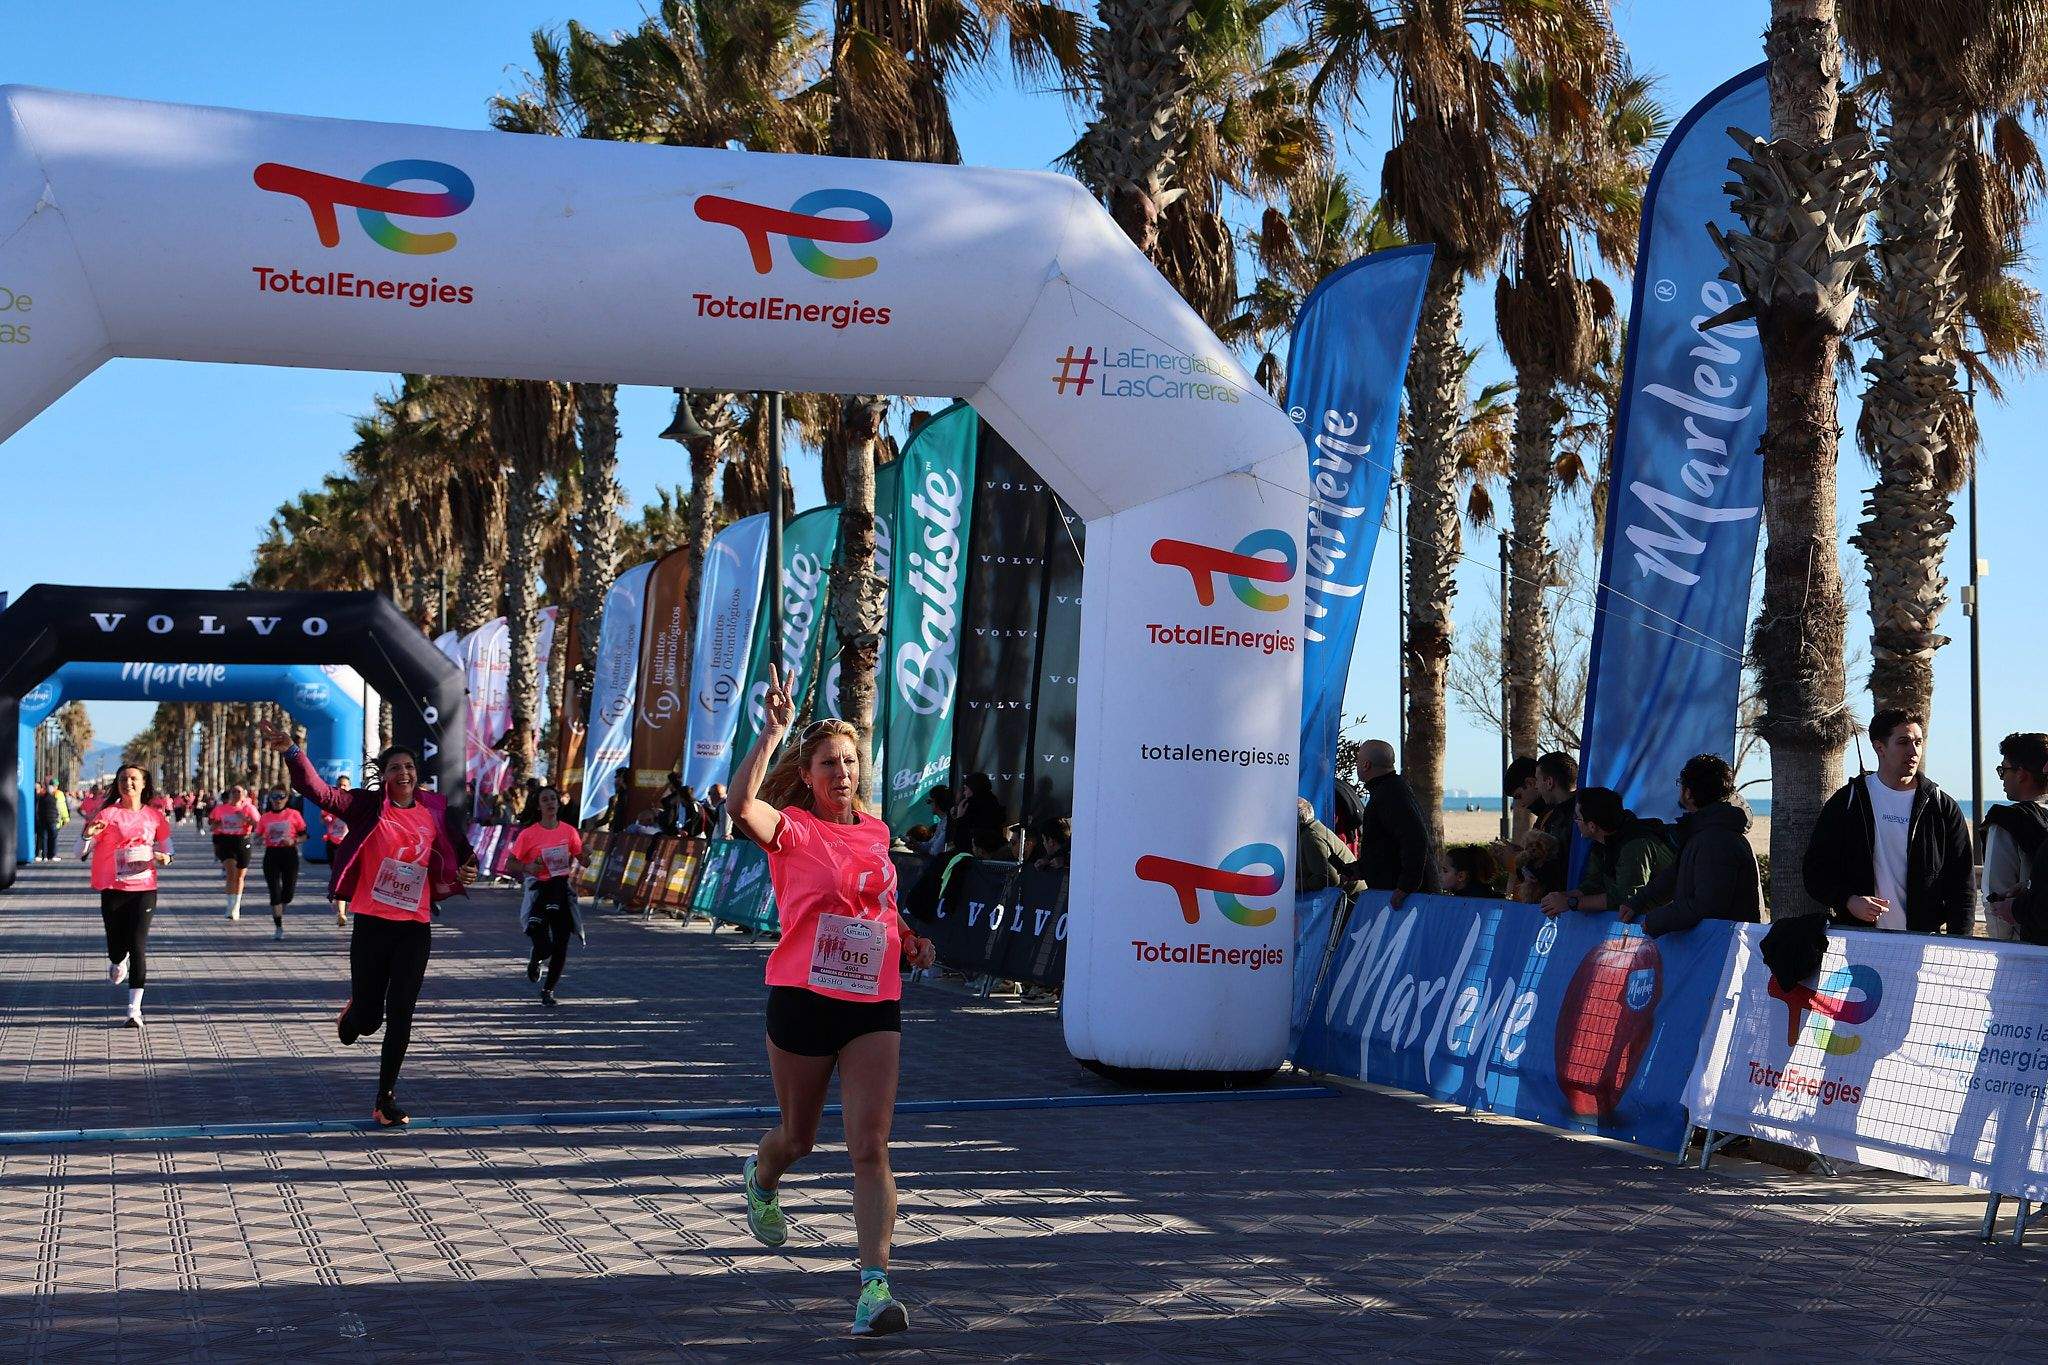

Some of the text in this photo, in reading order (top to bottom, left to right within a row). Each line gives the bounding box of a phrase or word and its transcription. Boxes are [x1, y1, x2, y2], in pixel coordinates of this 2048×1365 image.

[252, 266, 474, 308] TotalEnergies
[692, 293, 891, 329] TotalEnergies
[1101, 373, 1240, 404] LasCarreras
[1624, 279, 1759, 586] Marlene
[986, 481, 1051, 492] VOLV
[896, 468, 963, 720] Batiste
[90, 612, 329, 636] VOLVO
[710, 614, 726, 669] Institutos
[722, 587, 741, 670] Odontológicos
[1146, 624, 1295, 655] TotalEnergies
[652, 631, 667, 686] Institutos
[665, 606, 682, 686] Odontológicos
[121, 662, 226, 696] Marlene
[1140, 742, 1290, 767] totalenergies.es
[393, 881, 410, 892] 016
[967, 901, 1068, 941] VOLVO
[841, 949, 869, 965] 016
[1131, 941, 1283, 971] TotalEnergies
[1326, 906, 1539, 1089] Marlene
